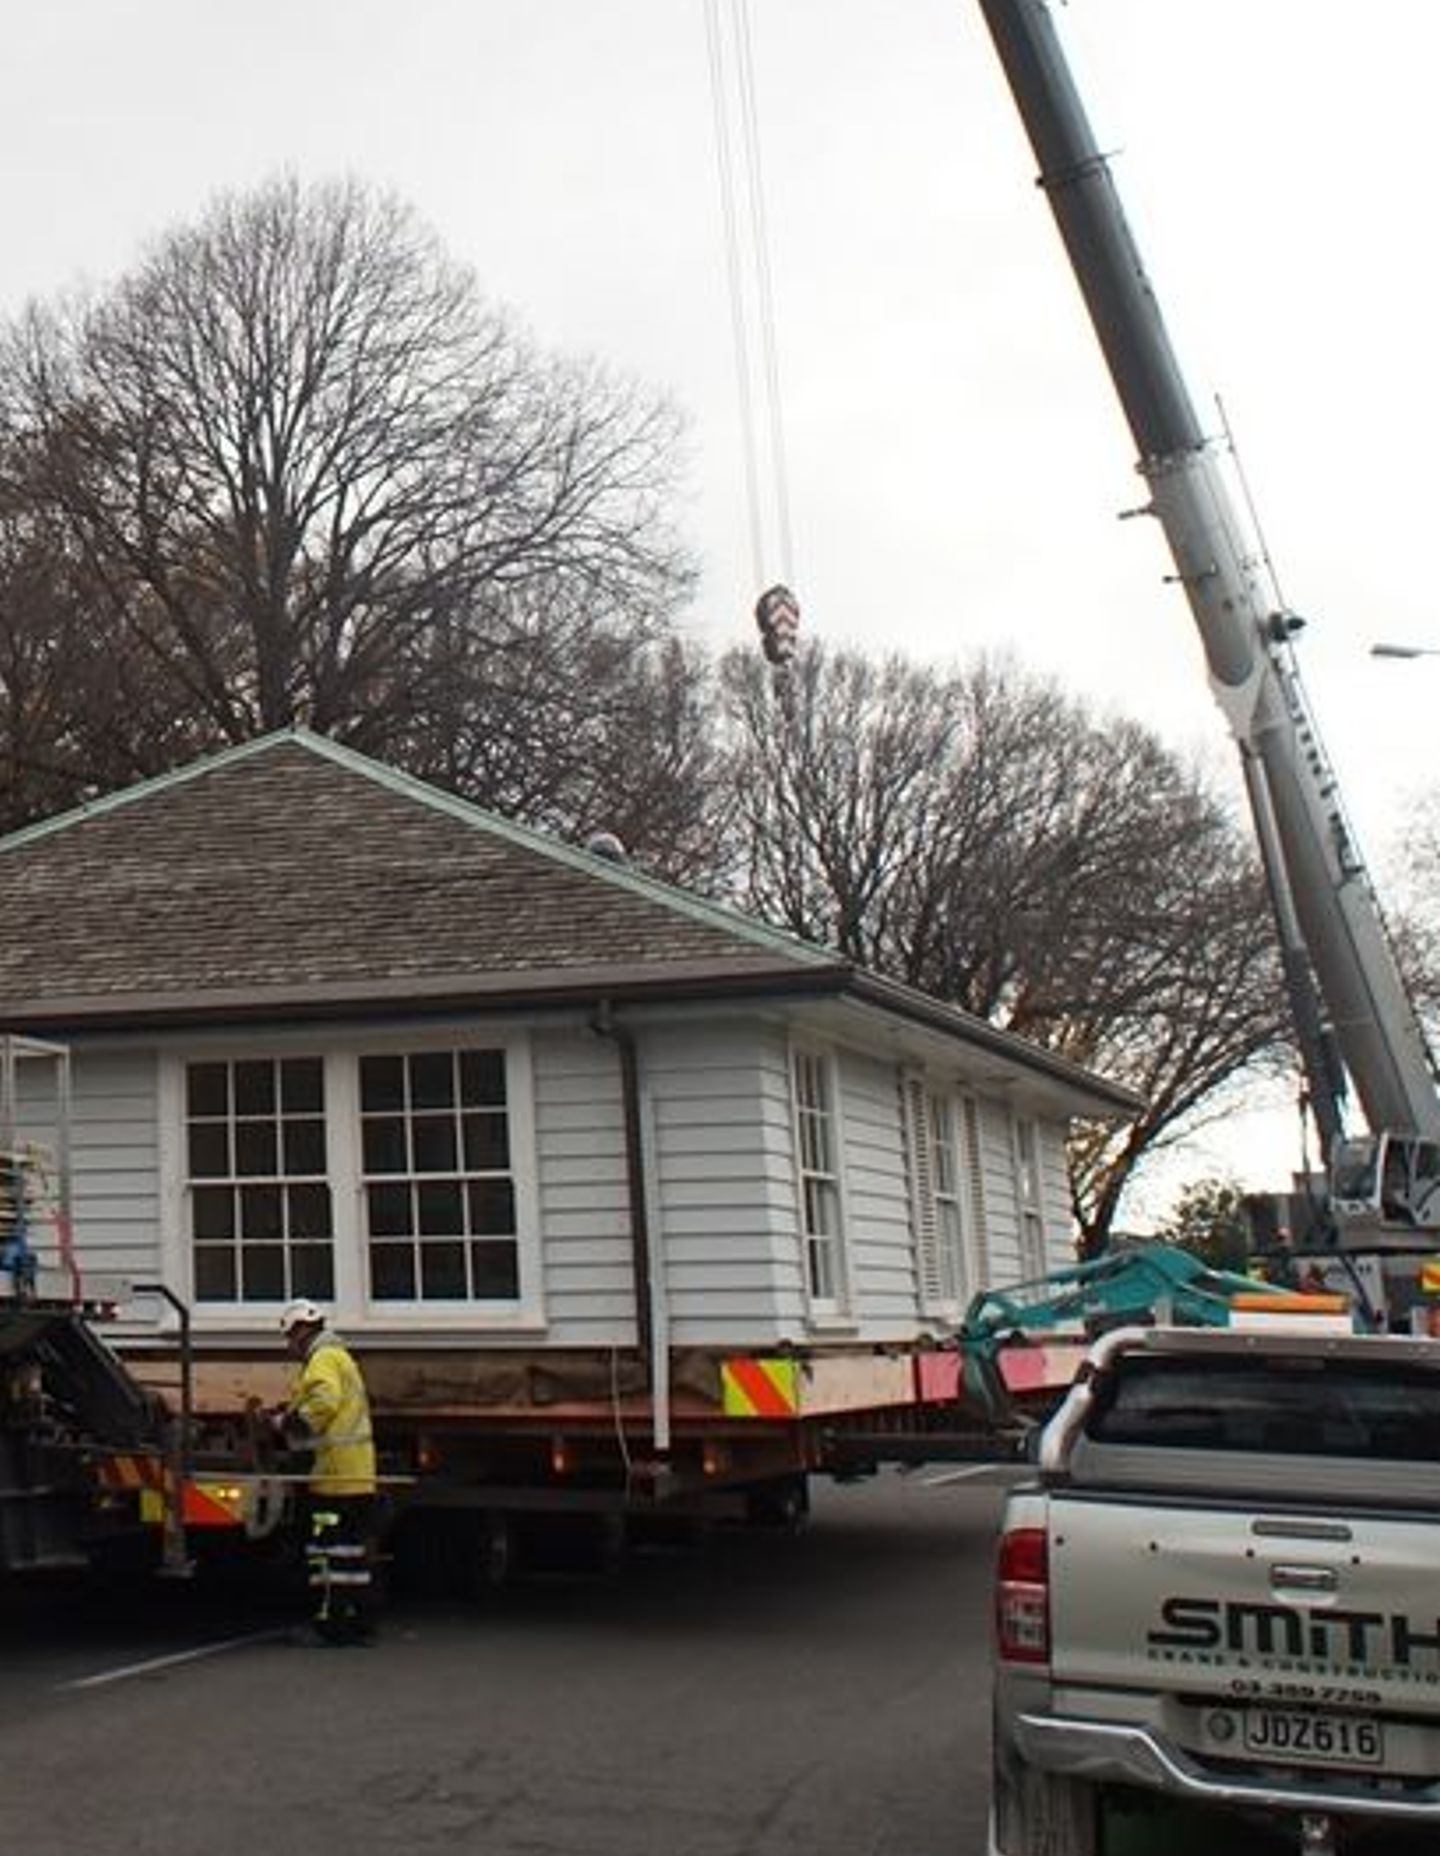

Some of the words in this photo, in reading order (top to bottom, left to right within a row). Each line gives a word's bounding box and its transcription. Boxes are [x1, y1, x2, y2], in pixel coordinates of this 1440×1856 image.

[1147, 1598, 1440, 1665] SMITH
[1262, 1658, 1440, 1685] CONSTRUCTIO
[1250, 1713, 1377, 1756] JDZ616
